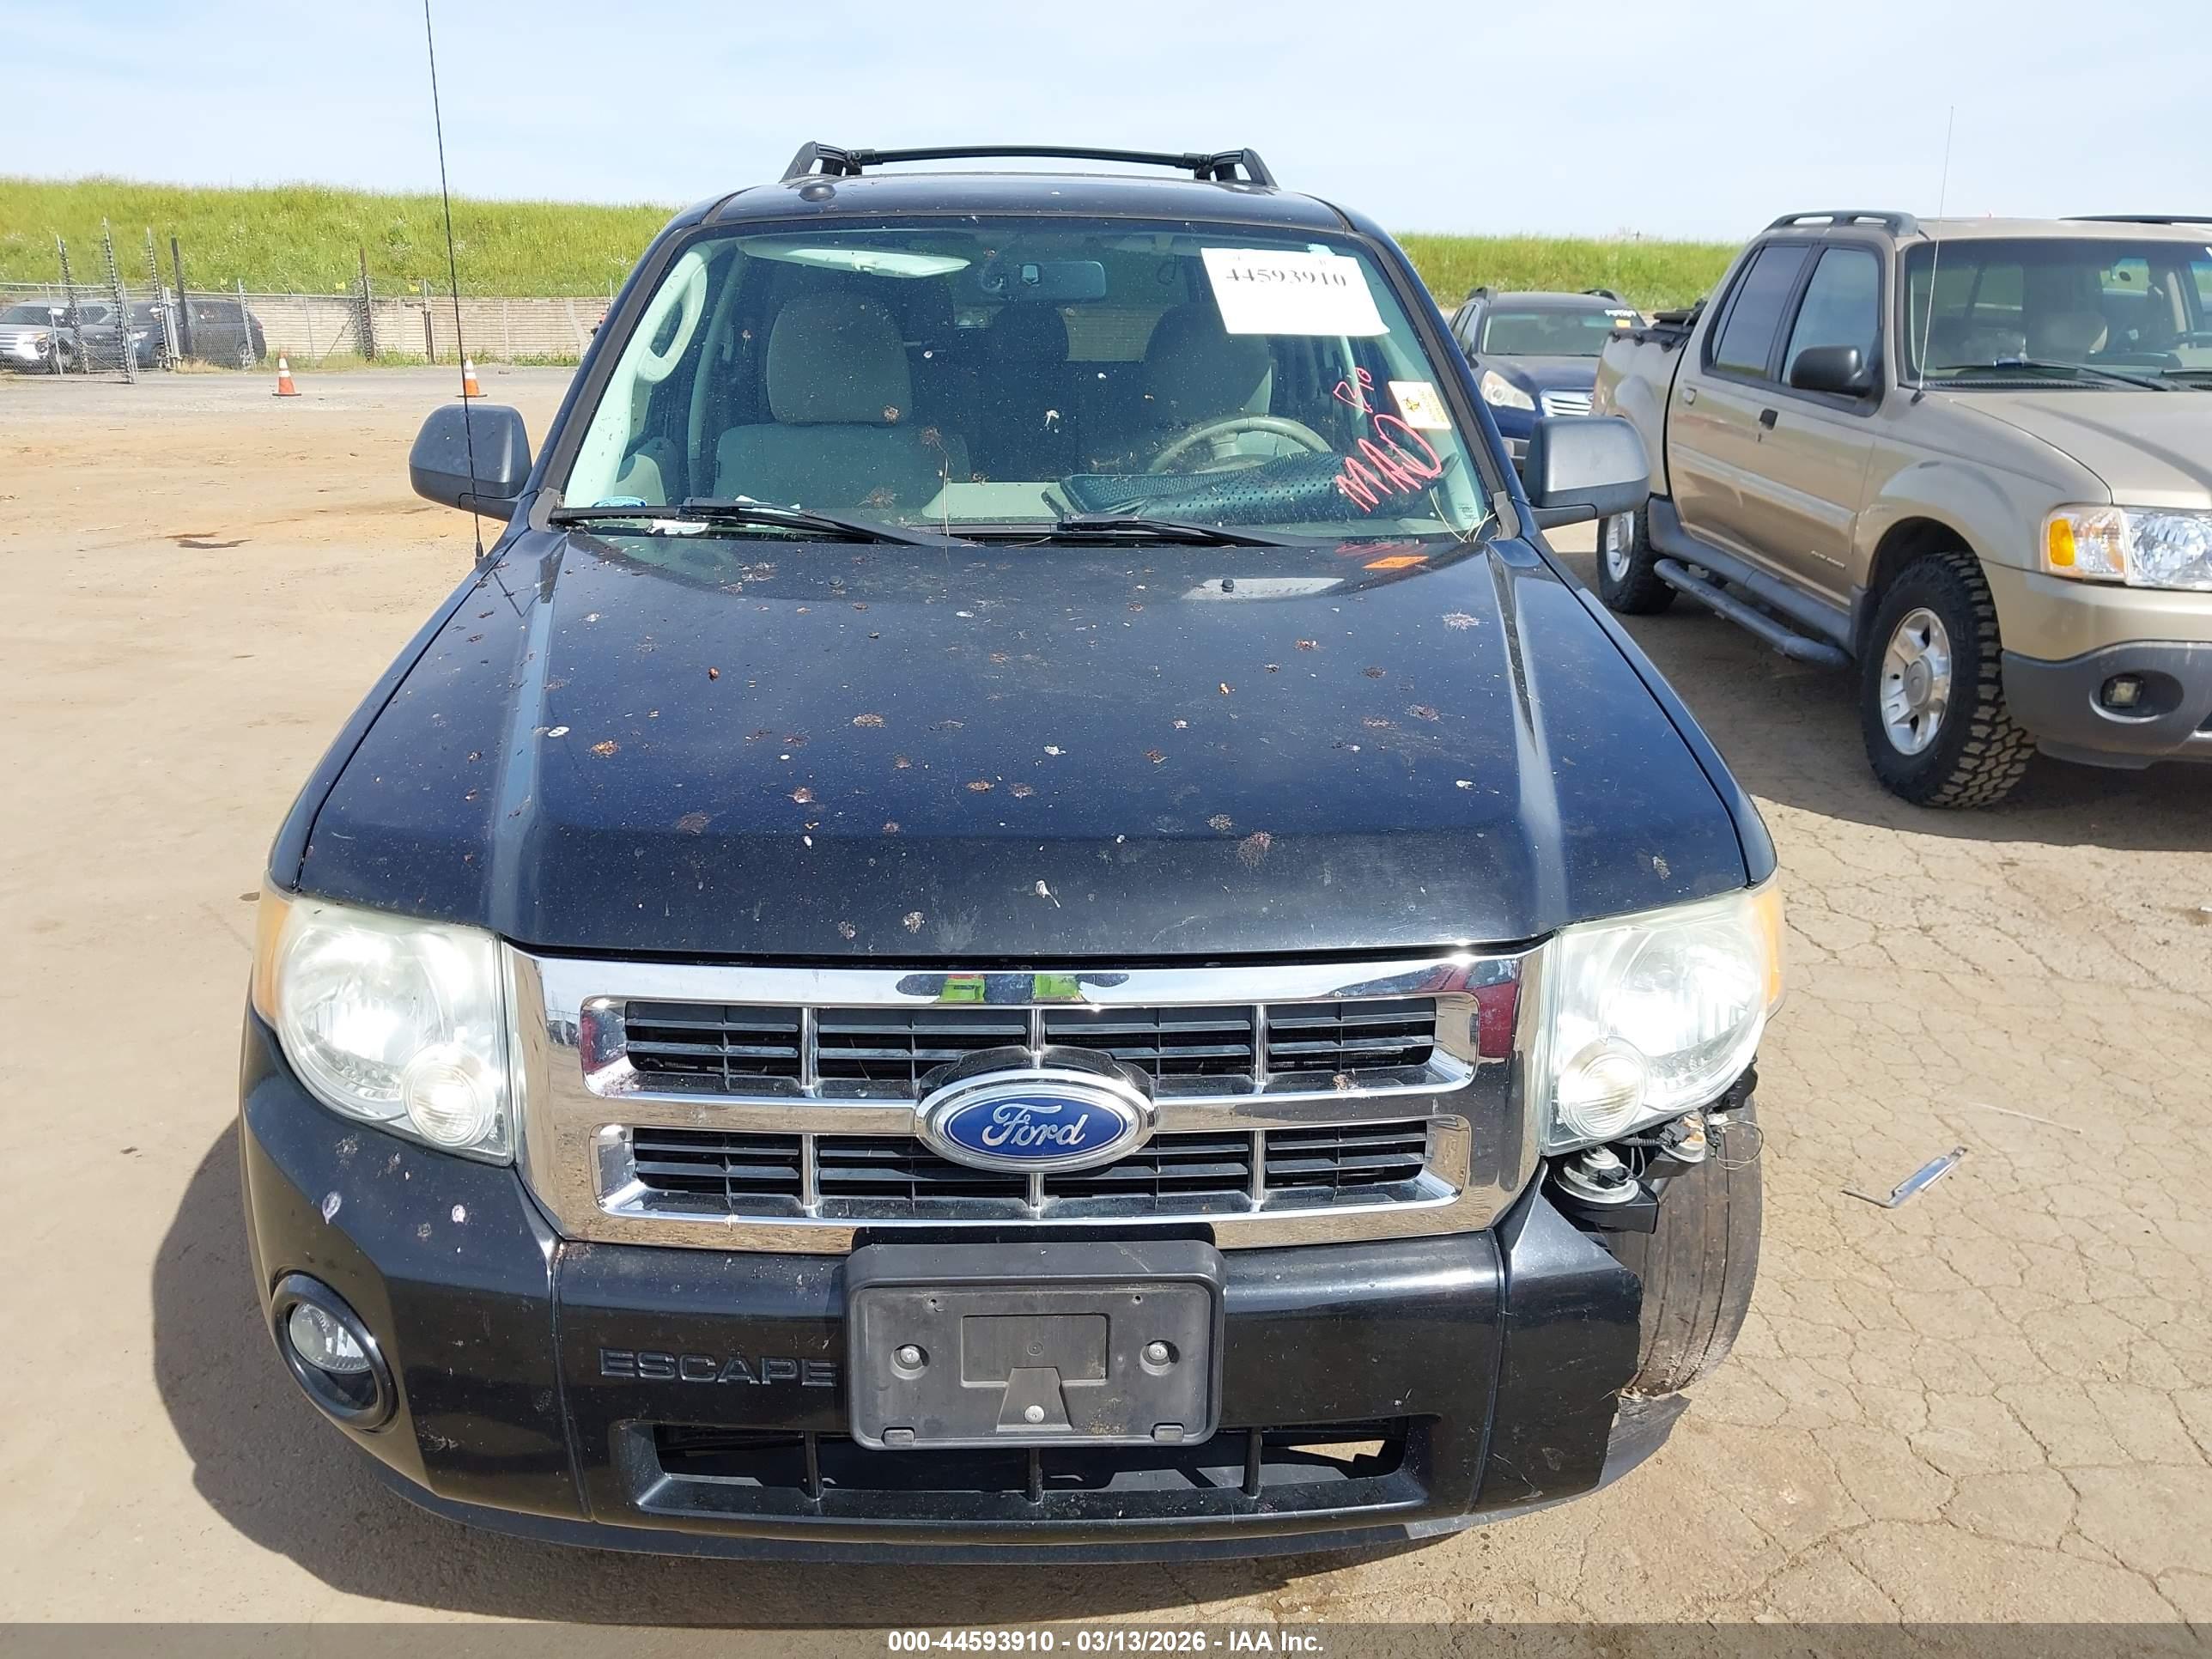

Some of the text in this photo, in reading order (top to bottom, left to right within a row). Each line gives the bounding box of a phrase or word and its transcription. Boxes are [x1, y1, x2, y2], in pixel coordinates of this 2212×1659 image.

[1225, 268, 1346, 287] 44593910
[981, 1103, 1089, 1146] Ford
[599, 1348, 838, 1387] ESCAPE
